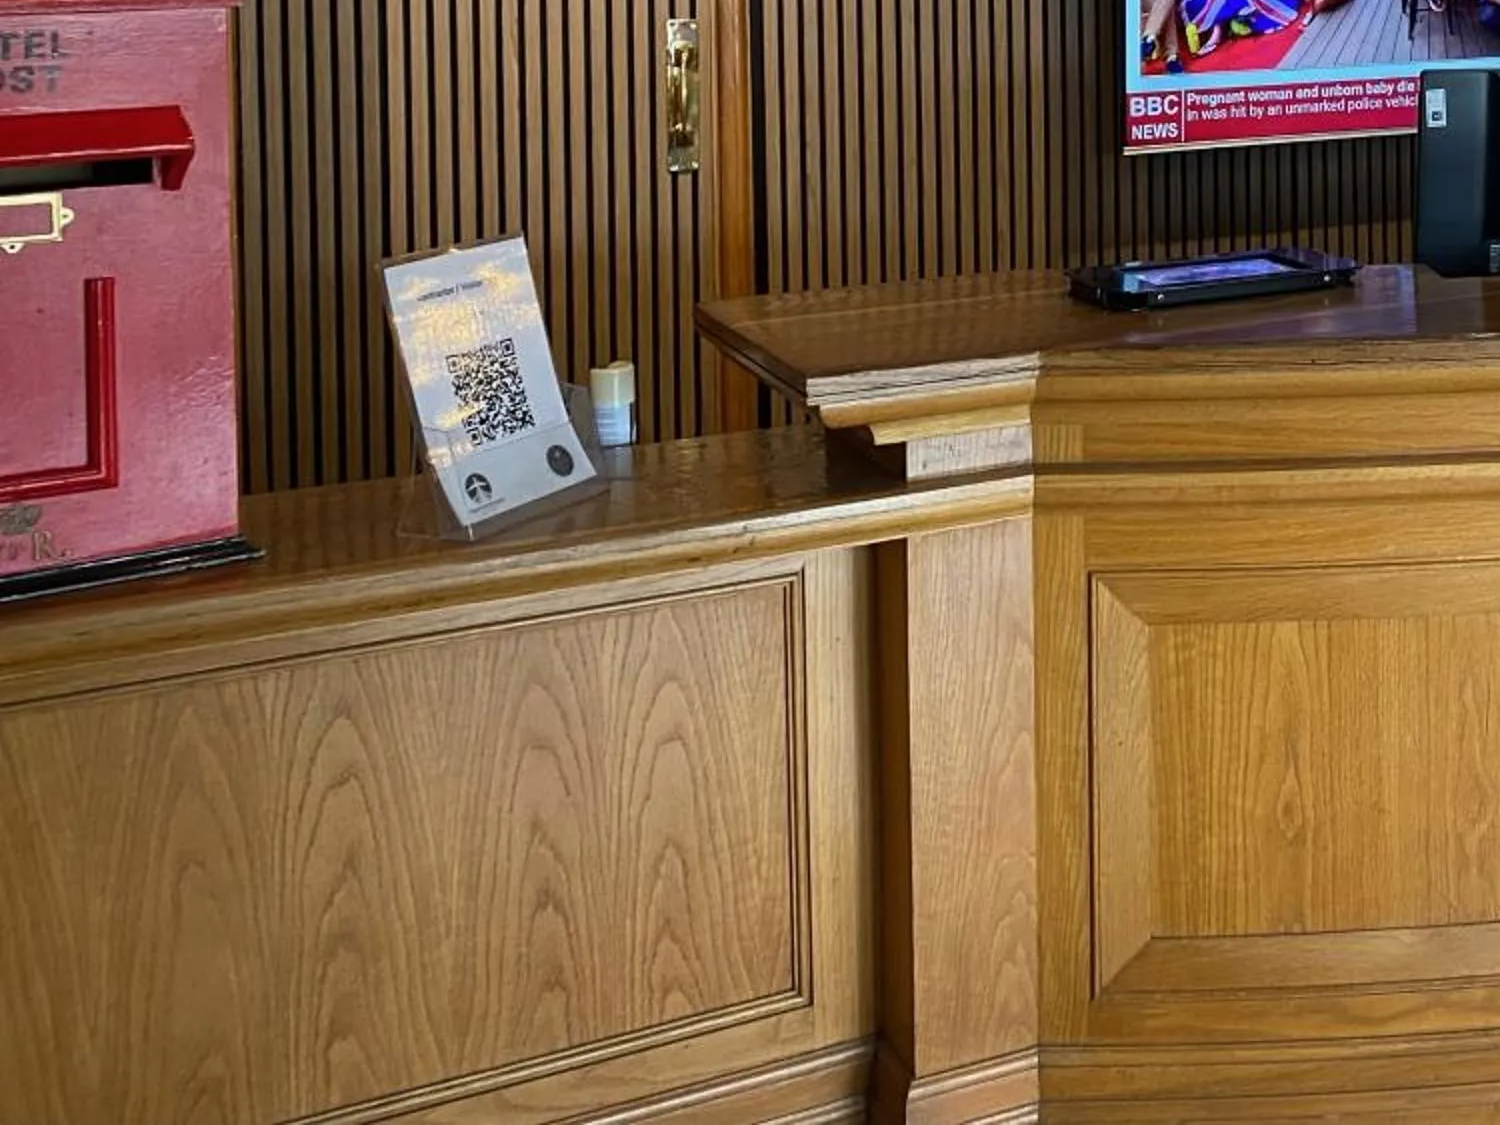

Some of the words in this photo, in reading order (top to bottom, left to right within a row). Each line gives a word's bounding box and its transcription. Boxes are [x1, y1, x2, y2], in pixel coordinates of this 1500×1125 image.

[1187, 90, 1245, 107] Pregnant
[1247, 89, 1293, 102] woman
[1295, 85, 1319, 98] and
[1321, 82, 1363, 96] unborn
[1365, 80, 1395, 95] baby
[1397, 78, 1415, 92] die
[1130, 94, 1179, 117] BBC
[1201, 107, 1227, 120] was
[1230, 104, 1247, 118] hit
[1249, 102, 1264, 119] by
[1267, 105, 1283, 116] an
[1285, 98, 1345, 114] unmarked
[1347, 96, 1383, 114] police
[1385, 92, 1420, 108] vehicl
[1131, 122, 1179, 140] NEWS
